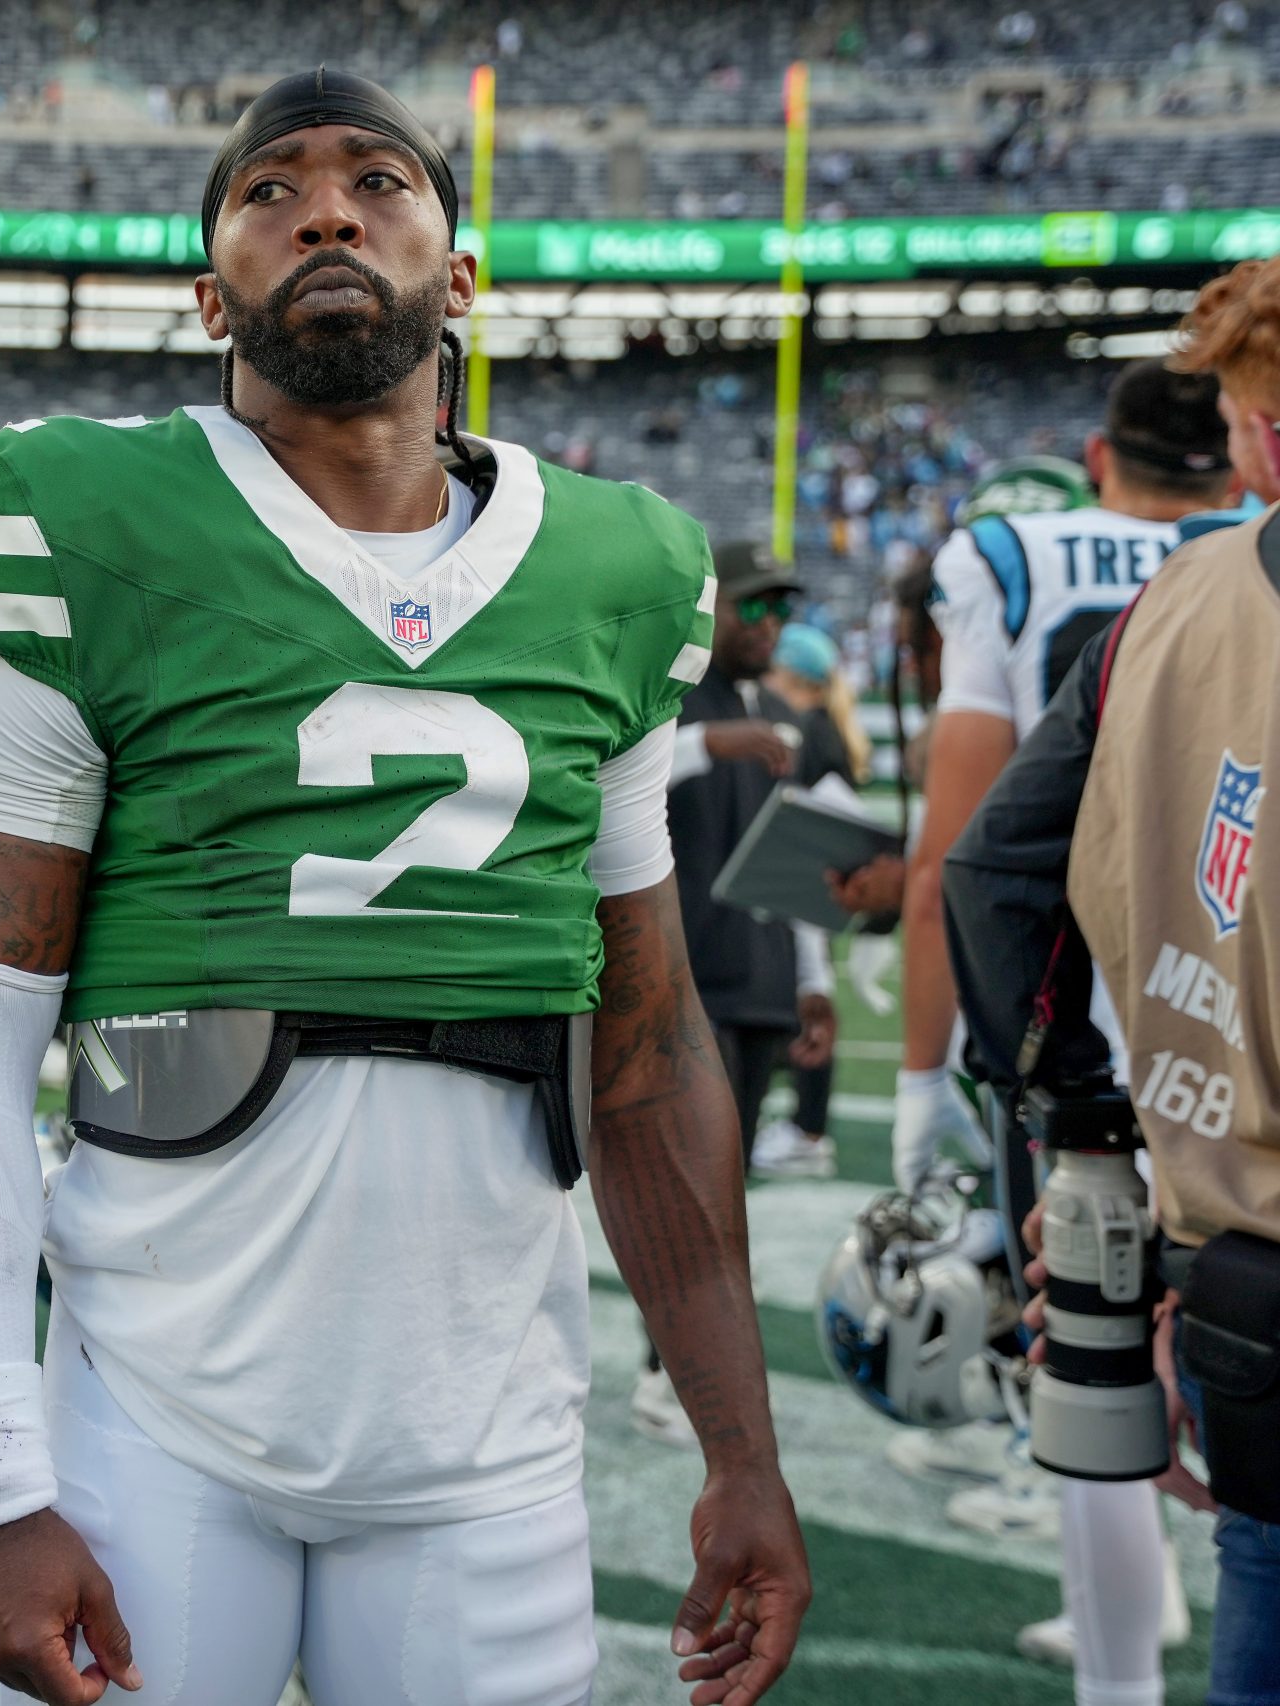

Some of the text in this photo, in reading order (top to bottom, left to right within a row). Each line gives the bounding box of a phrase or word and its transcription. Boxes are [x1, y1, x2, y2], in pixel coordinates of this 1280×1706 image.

[395, 618, 428, 642] NFL
[288, 681, 529, 918] 2
[1136, 1050, 1235, 1140] 168
